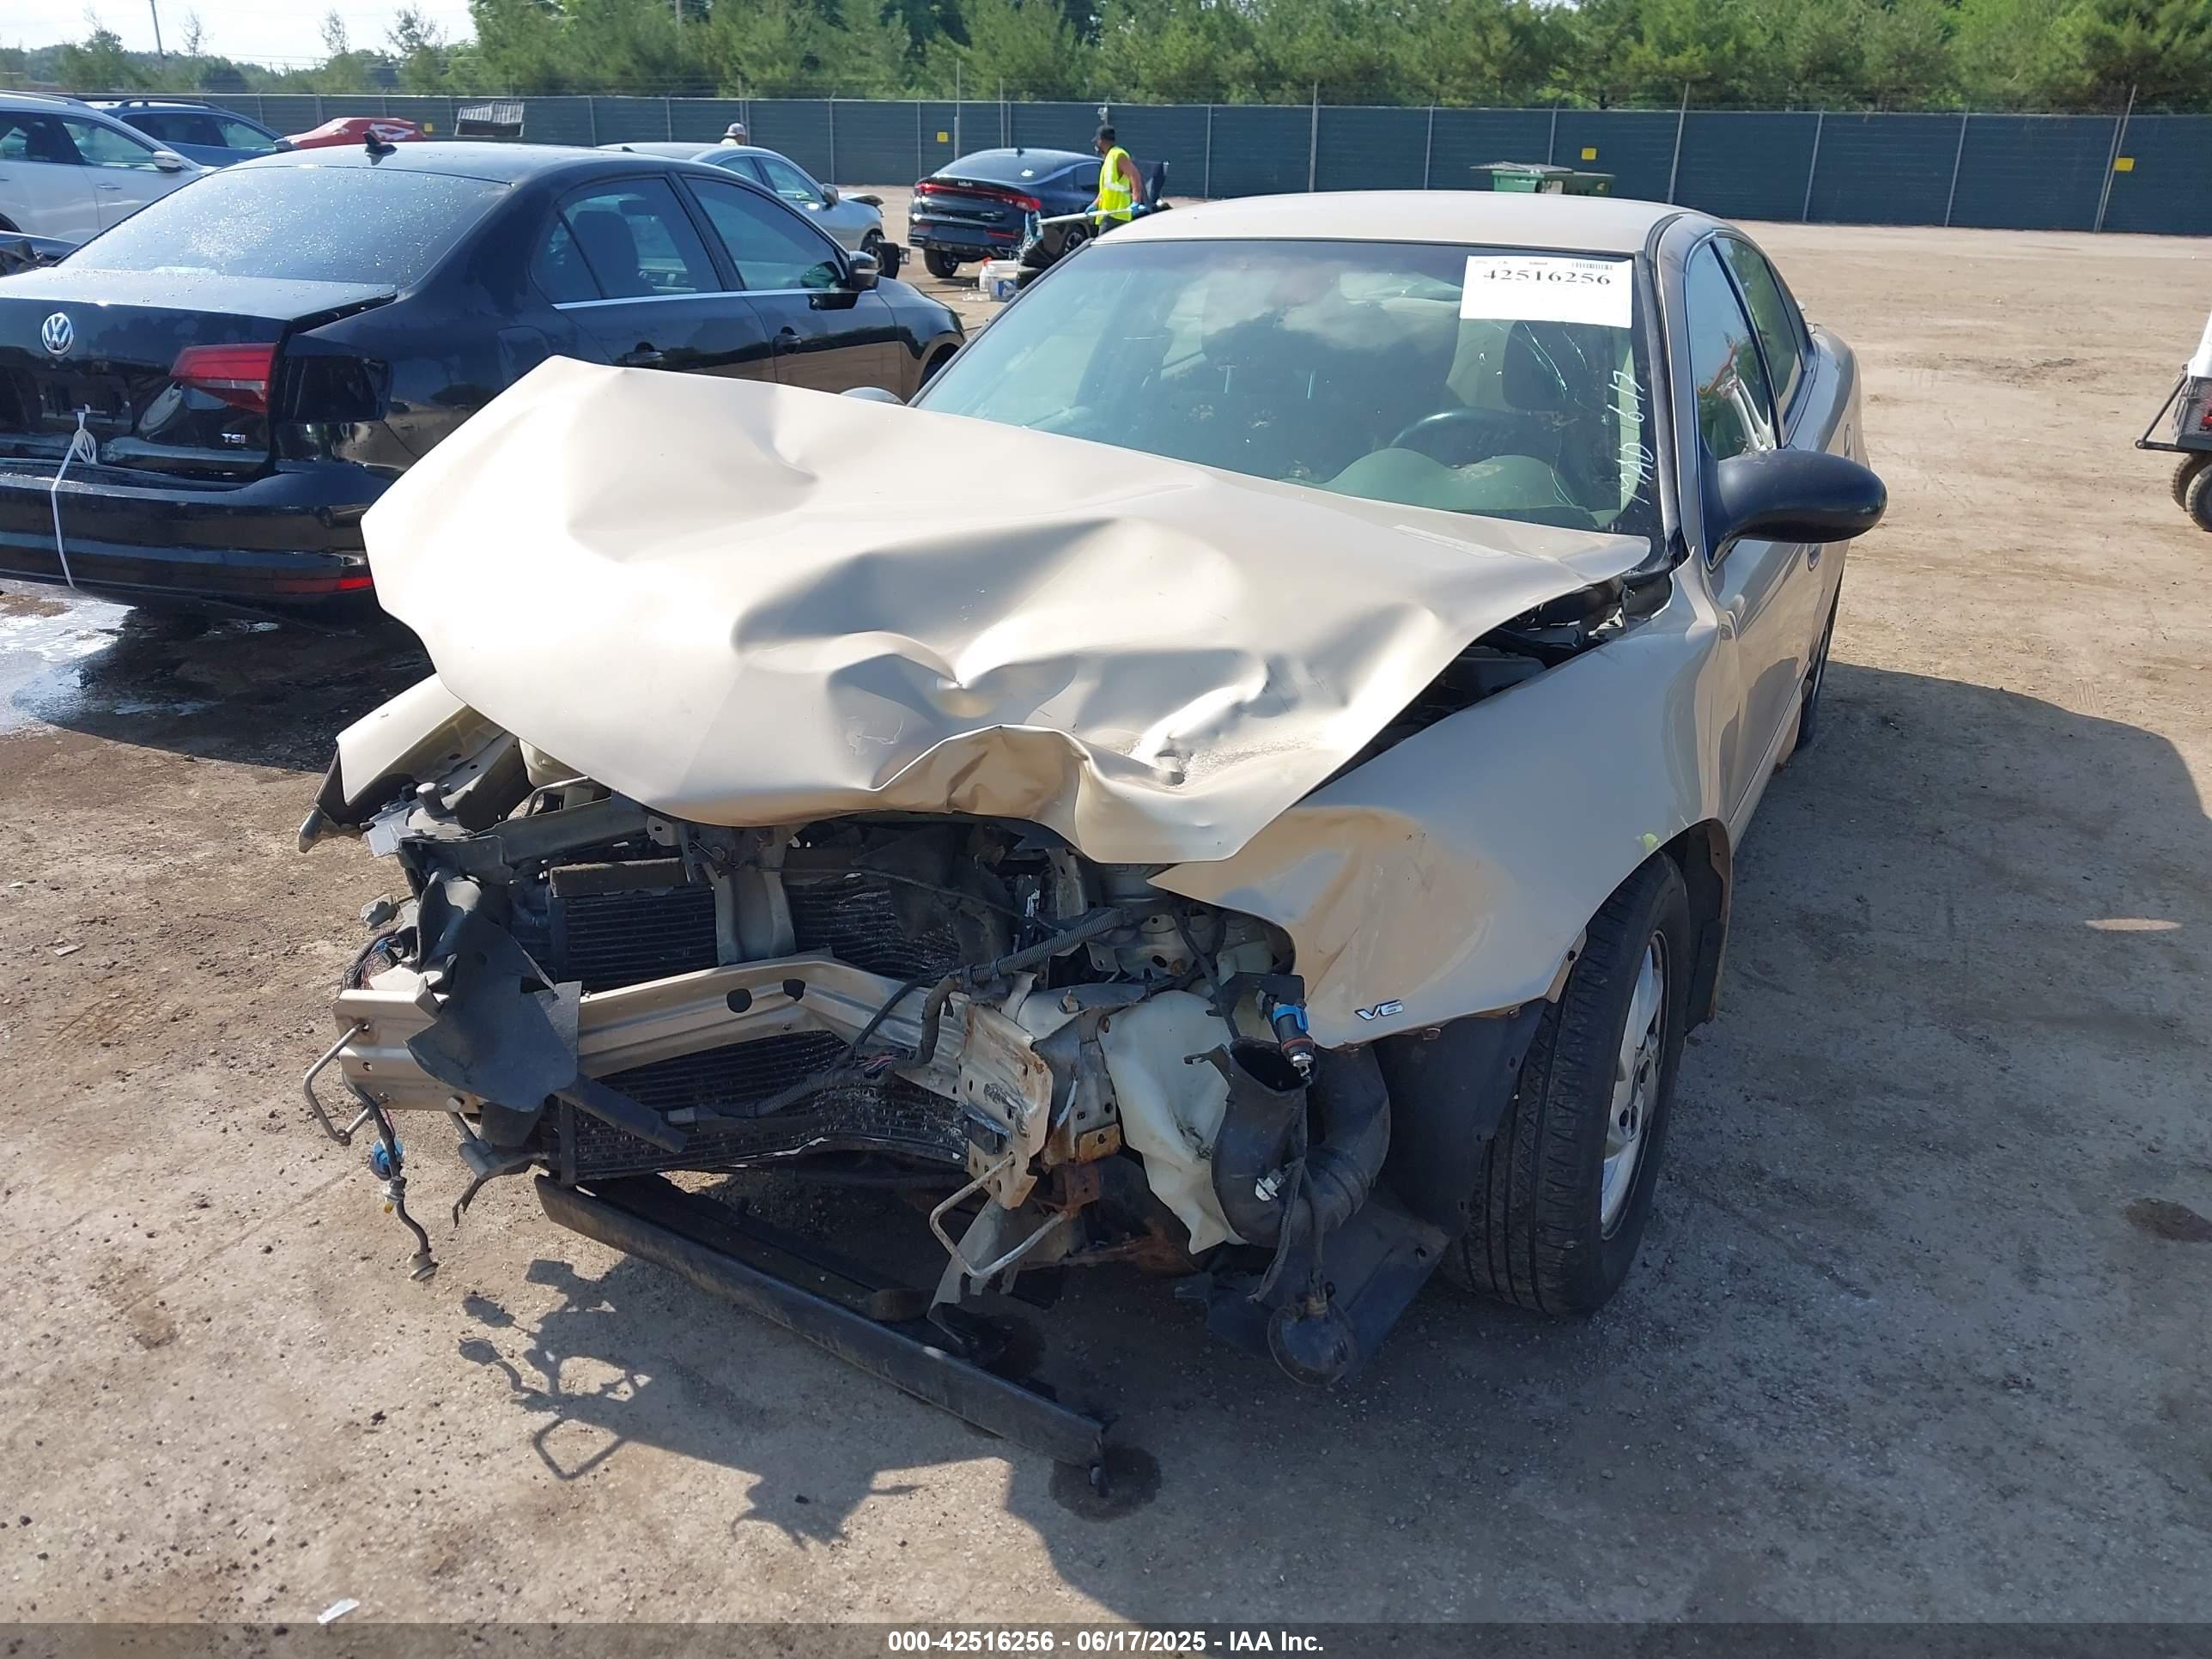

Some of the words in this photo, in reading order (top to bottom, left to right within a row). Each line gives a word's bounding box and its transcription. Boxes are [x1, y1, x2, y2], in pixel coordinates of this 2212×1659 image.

[1483, 269, 1612, 286] 42516256
[42, 312, 75, 356] VW
[1607, 369, 1646, 423] 6-17
[221, 432, 246, 445] TSI
[1354, 999, 1403, 1021] V6
